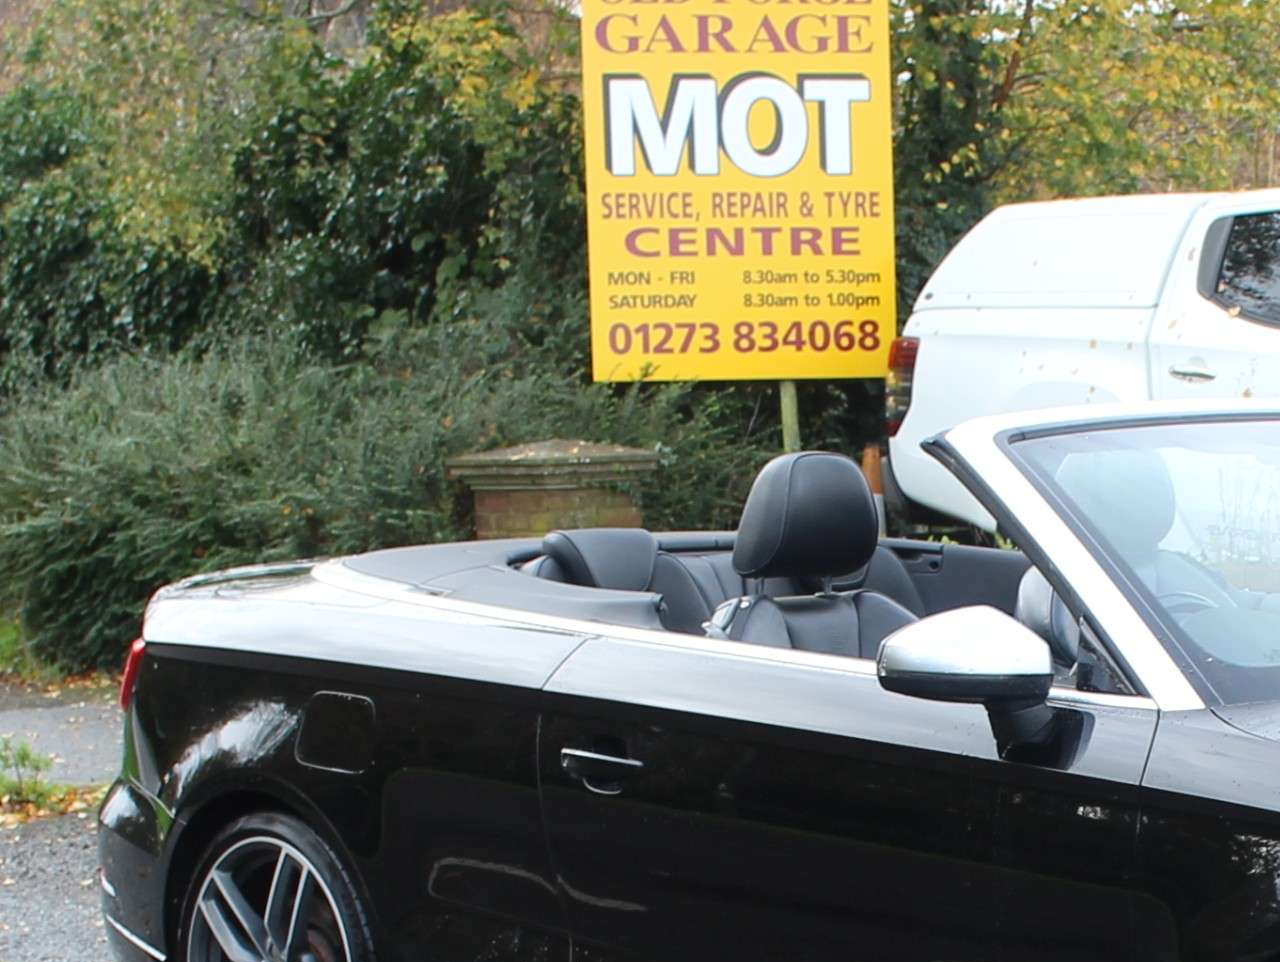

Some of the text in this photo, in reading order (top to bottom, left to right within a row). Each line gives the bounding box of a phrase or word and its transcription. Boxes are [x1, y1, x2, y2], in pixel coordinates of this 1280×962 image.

[594, 12, 875, 54] GARAGE
[602, 71, 871, 177] MOT
[601, 191, 882, 221] SERVICE, REPAIR & TYRE
[624, 226, 861, 258] CENTRE
[607, 271, 651, 286] MON
[669, 271, 696, 286] FRI
[742, 269, 882, 288] 8.30am to 5.30pm
[608, 293, 698, 310] SATURDAY
[743, 292, 882, 311] 8.30am to 1.00pm
[608, 319, 881, 356] 01273 834068
